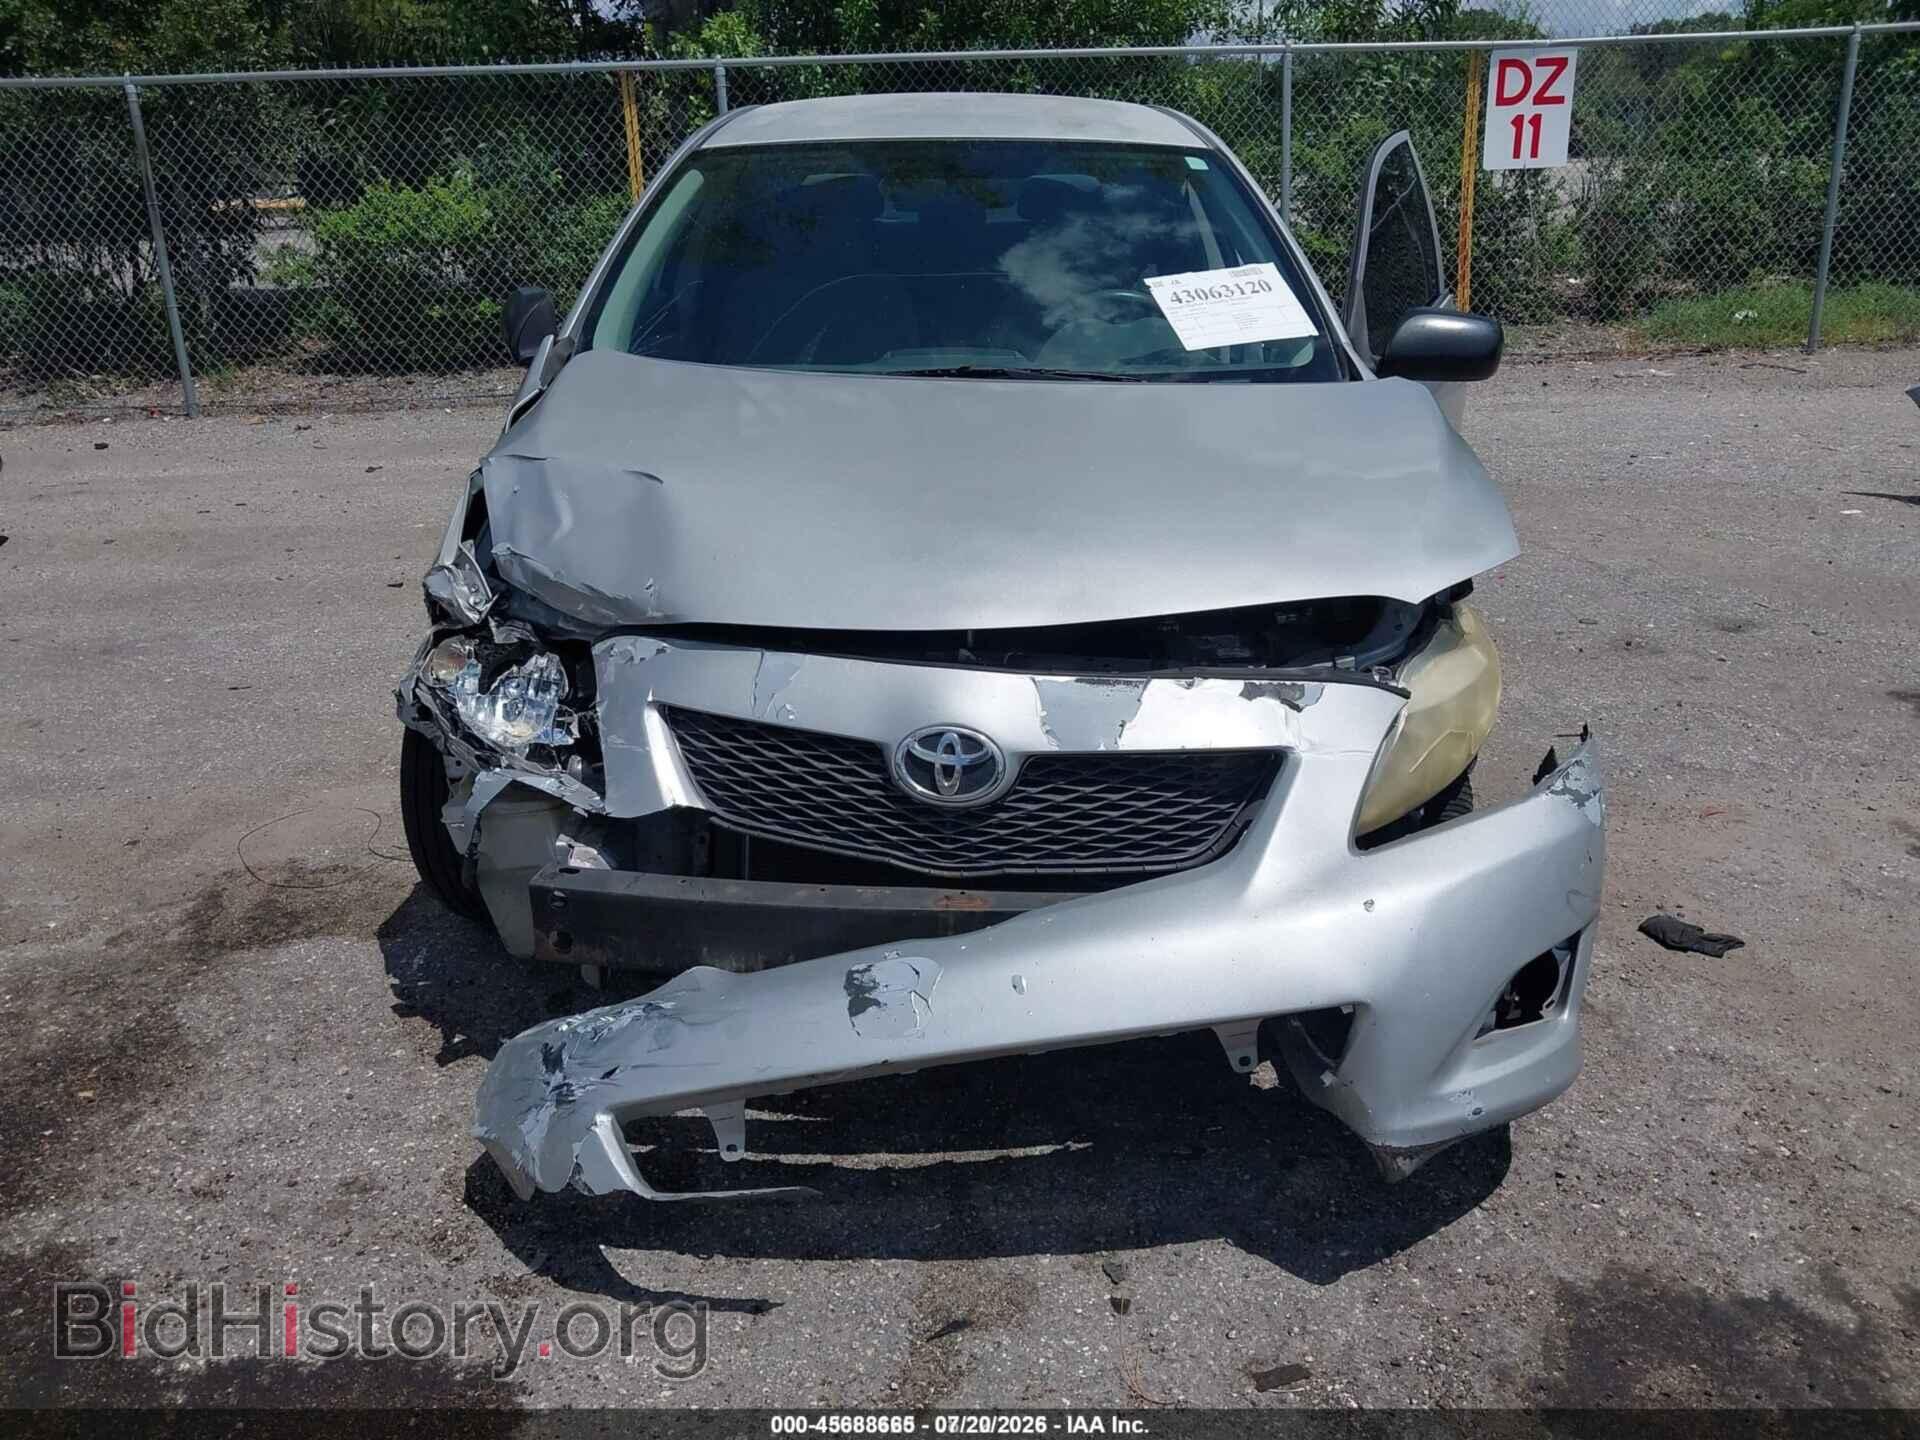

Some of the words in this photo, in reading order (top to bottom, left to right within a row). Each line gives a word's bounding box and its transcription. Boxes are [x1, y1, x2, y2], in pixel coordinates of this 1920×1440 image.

[1496, 57, 1568, 106] DZ
[1510, 113, 1542, 159] 11
[1170, 279, 1273, 304] 43063120
